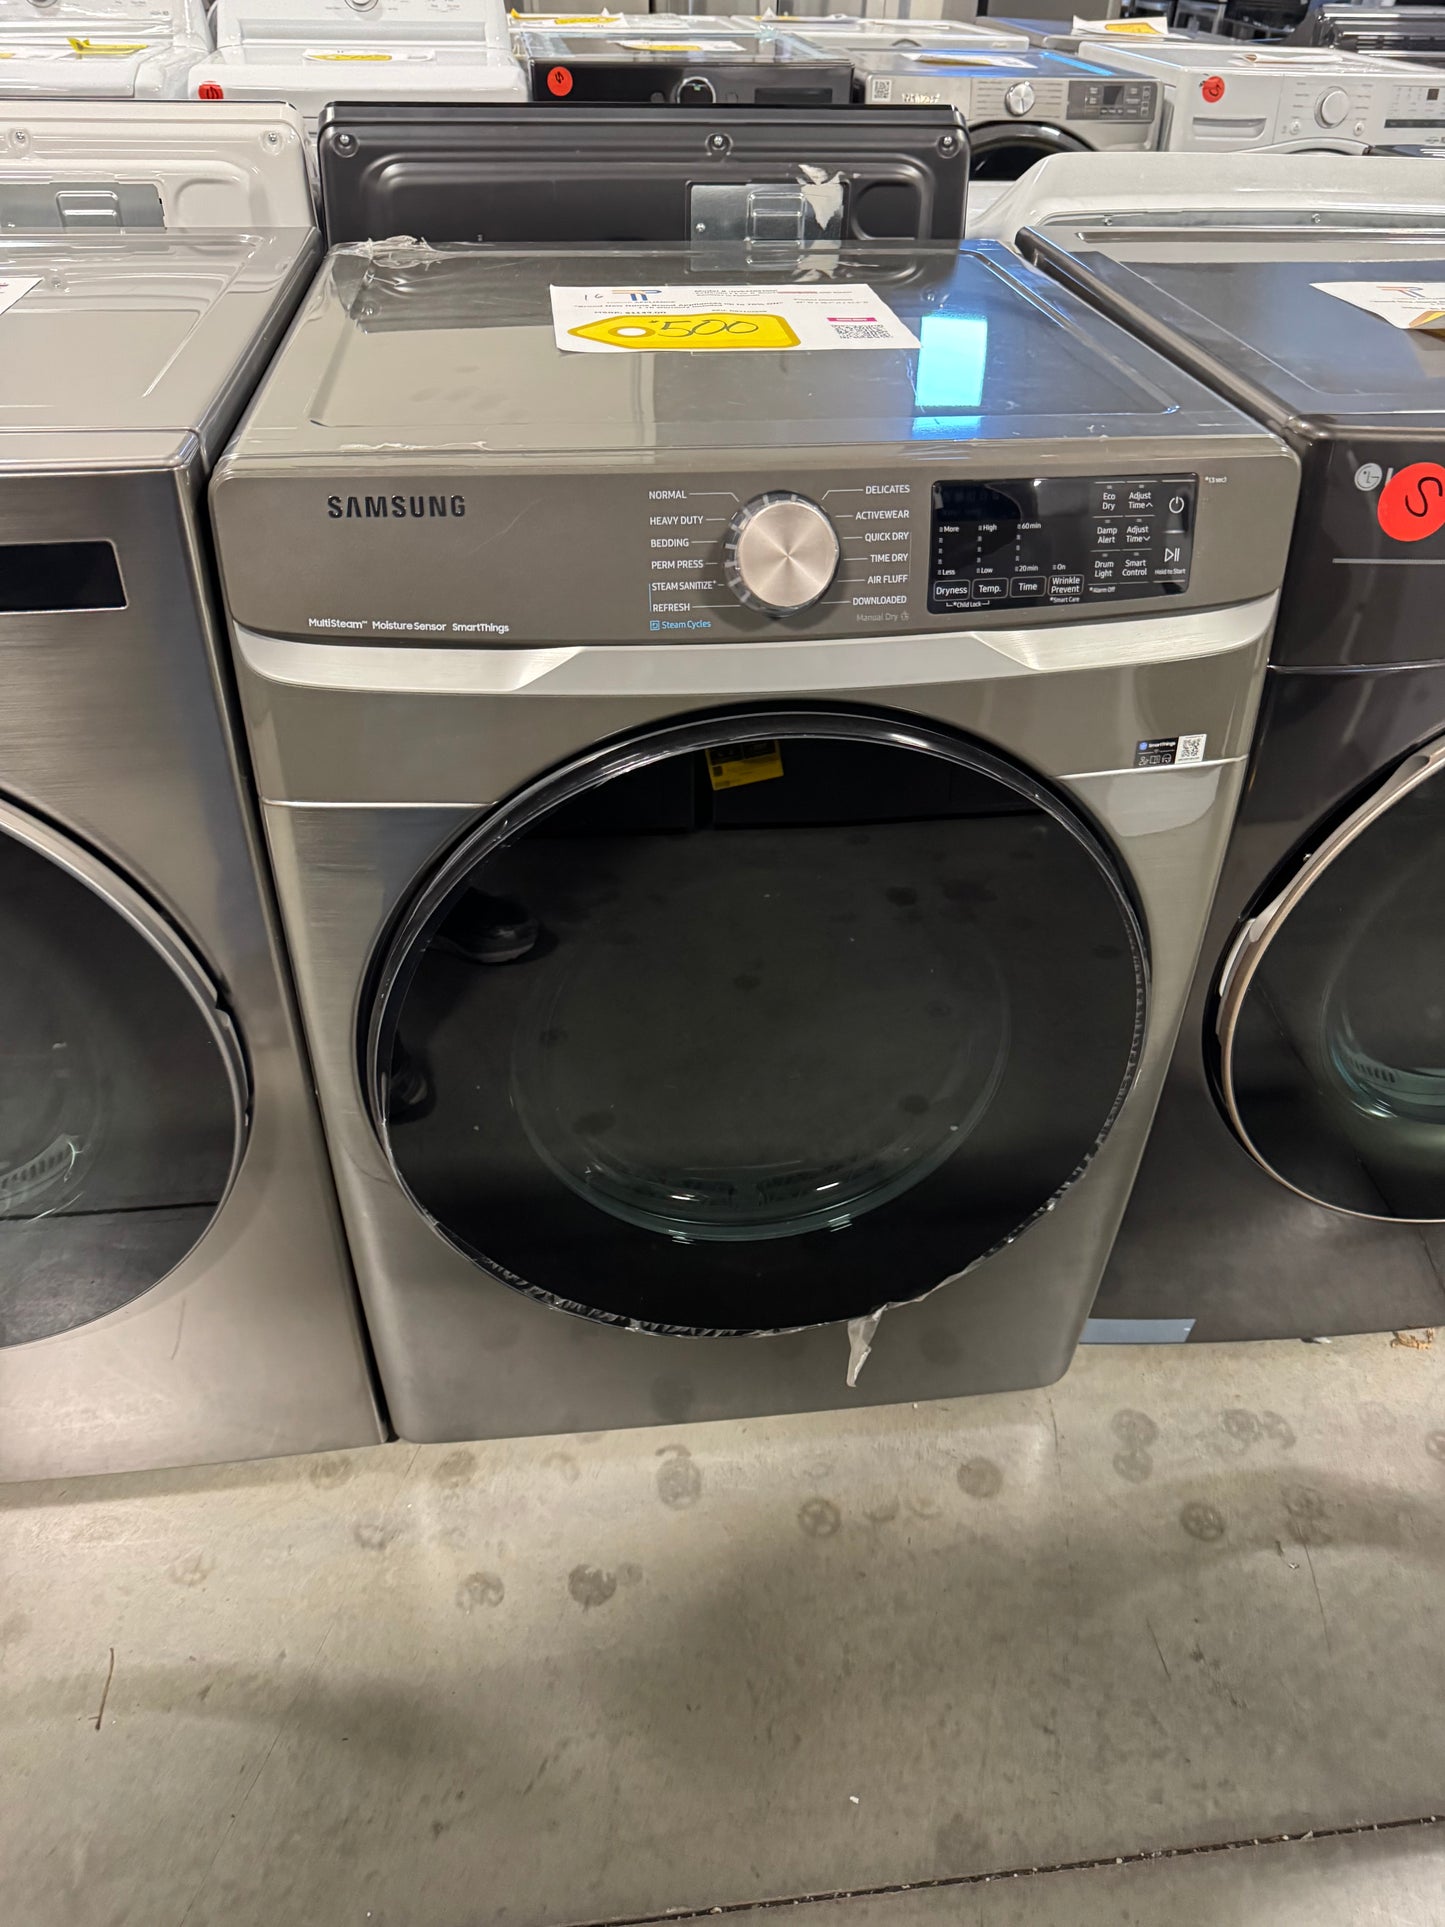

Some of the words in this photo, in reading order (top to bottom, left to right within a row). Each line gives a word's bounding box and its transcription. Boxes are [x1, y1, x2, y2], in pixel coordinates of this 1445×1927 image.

[866, 484, 910, 494] DELICATES
[649, 490, 687, 499] NORMAL
[1103, 492, 1116, 500] Eco
[1129, 491, 1151, 501] Adjust
[327, 495, 466, 519] SAMSUNG
[1102, 502, 1115, 511] Dry
[1128, 501, 1146, 509] Time
[856, 510, 909, 520] ACTIVEWEAR
[650, 516, 678, 525] HEAVY
[680, 515, 704, 525] DUTY
[982, 523, 997, 532] High
[1097, 527, 1118, 535] Damp
[1126, 526, 1149, 535] Adjust
[865, 532, 890, 542] QUICK
[892, 531, 909, 541] DRY
[1097, 536, 1116, 544] Alert
[1126, 535, 1143, 543] Time
[650, 538, 689, 548] BEDDING
[870, 553, 890, 563] TIME
[891, 553, 909, 562] DRY
[651, 560, 676, 569] PERM
[677, 560, 704, 569] PRESS
[1094, 560, 1114, 568] Drum
[1125, 559, 1146, 567] Smart
[1094, 569, 1113, 579] Light
[1122, 568, 1148, 576] Control
[1173, 567, 1186, 575] Start
[867, 575, 882, 584] AIR
[883, 574, 908, 583] FLUFF
[1052, 576, 1080, 585] Wrinkle
[652, 582, 679, 591] STEAM
[936, 585, 968, 596] Dryness
[979, 584, 1002, 594] Temp.
[1018, 582, 1038, 591] Time
[1051, 585, 1080, 594] Prevent
[852, 595, 907, 605] DOWNLOADED
[653, 603, 690, 612] REFRESH
[856, 613, 883, 622] Manual
[885, 612, 898, 622] Dry
[372, 620, 413, 632] Moisture
[414, 621, 447, 632] Sensor
[452, 622, 510, 634] SmartThings
[661, 620, 687, 629] Steam
[687, 620, 712, 630] Cycles
